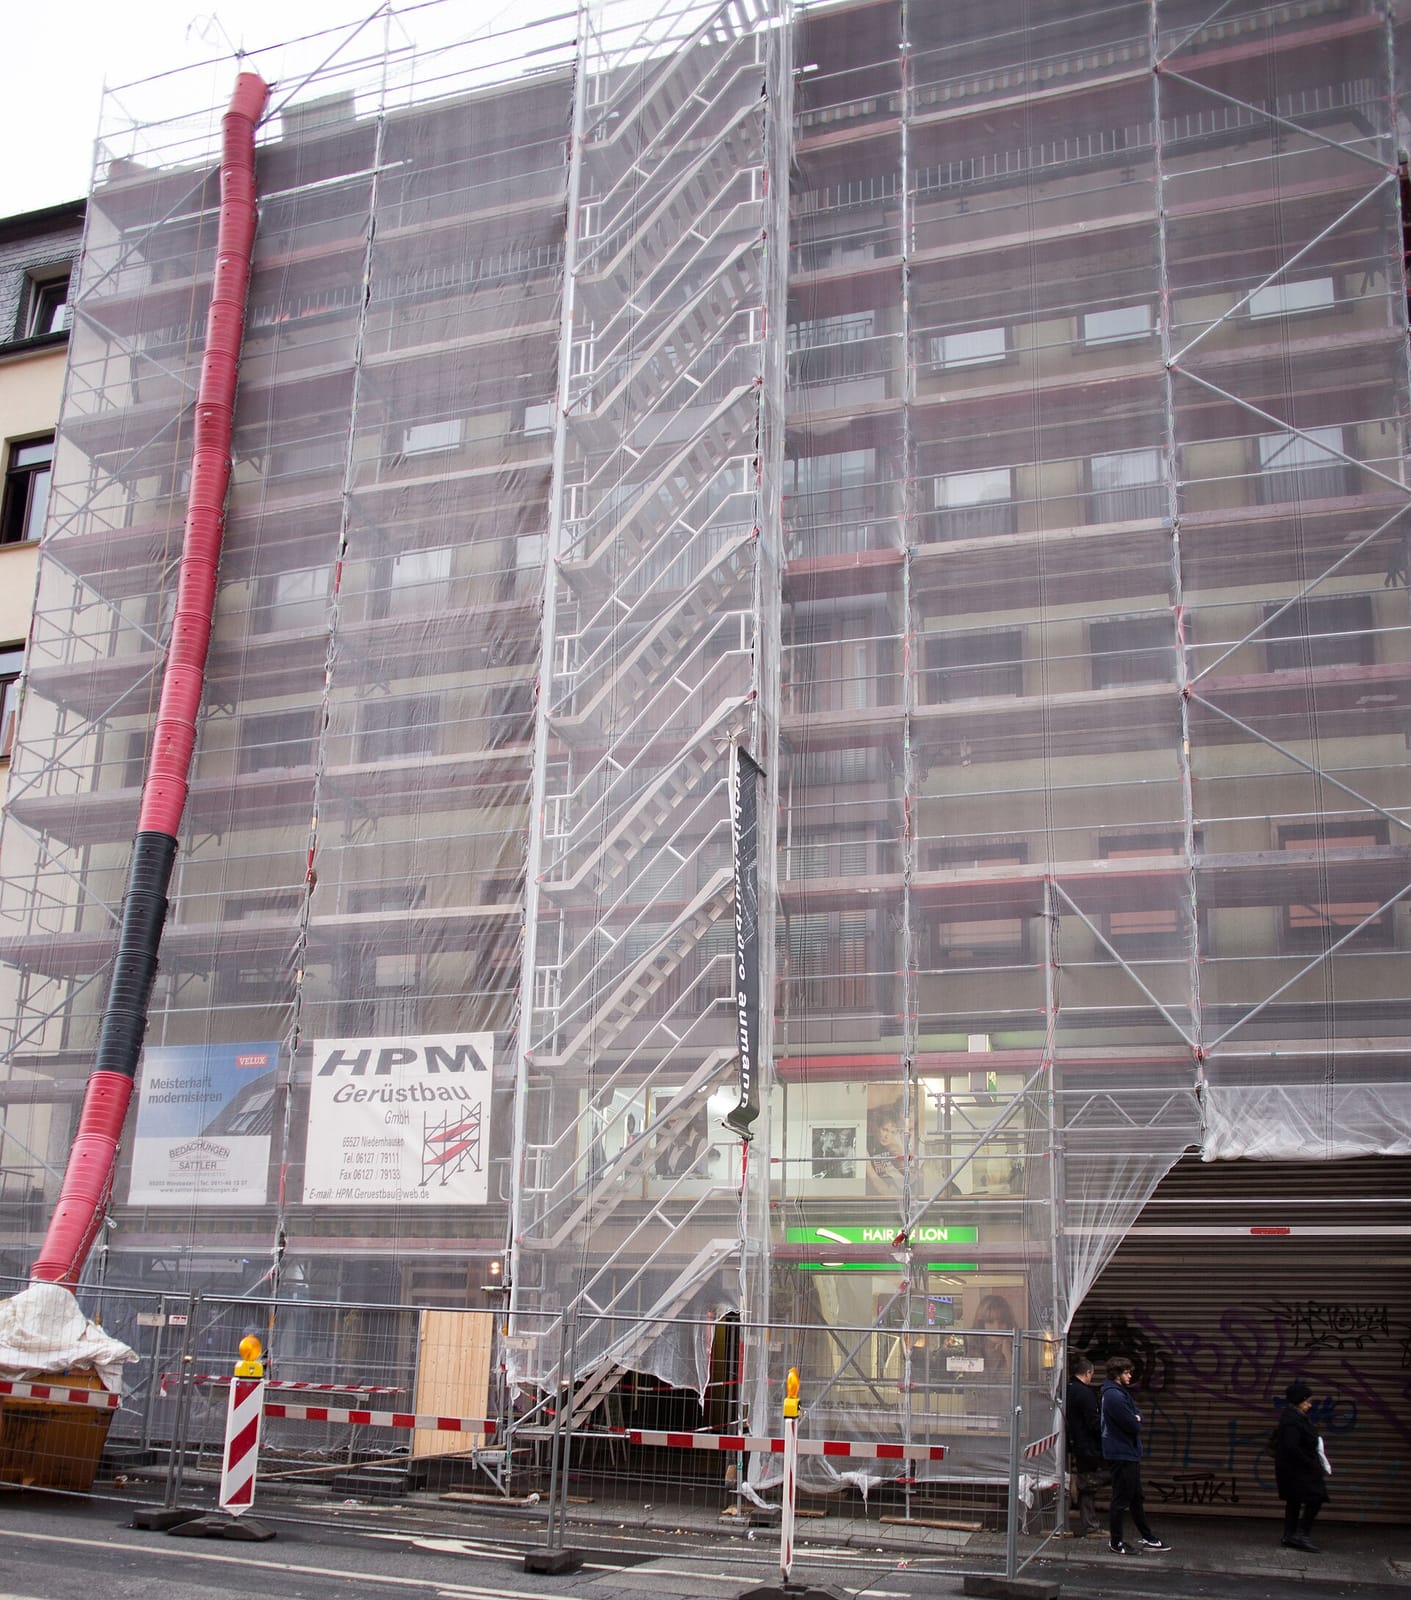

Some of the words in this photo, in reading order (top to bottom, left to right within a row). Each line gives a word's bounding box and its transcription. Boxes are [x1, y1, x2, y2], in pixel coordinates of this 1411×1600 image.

[738, 991, 750, 1109] aumann
[239, 1056, 266, 1065] VELUX
[317, 1044, 488, 1077] HPM
[150, 1077, 213, 1090] Meisterhaft
[148, 1092, 223, 1105] modernisieren
[333, 1082, 472, 1104] Gerüstbau
[384, 1110, 410, 1125] GmbH
[361, 1135, 405, 1148] Niedernhausen
[169, 1142, 231, 1159] BEDACHUNGEN
[343, 1152, 354, 1164] Tel.
[355, 1152, 375, 1164] 06127
[381, 1152, 400, 1164] 79111
[178, 1161, 217, 1170] SATTLER
[339, 1168, 352, 1180] Fax
[353, 1168, 374, 1180] 06127
[380, 1168, 401, 1180] 79133
[309, 1188, 334, 1200] E-mail:
[863, 1228, 894, 1241] HAIR
[897, 1228, 948, 1241] LON
